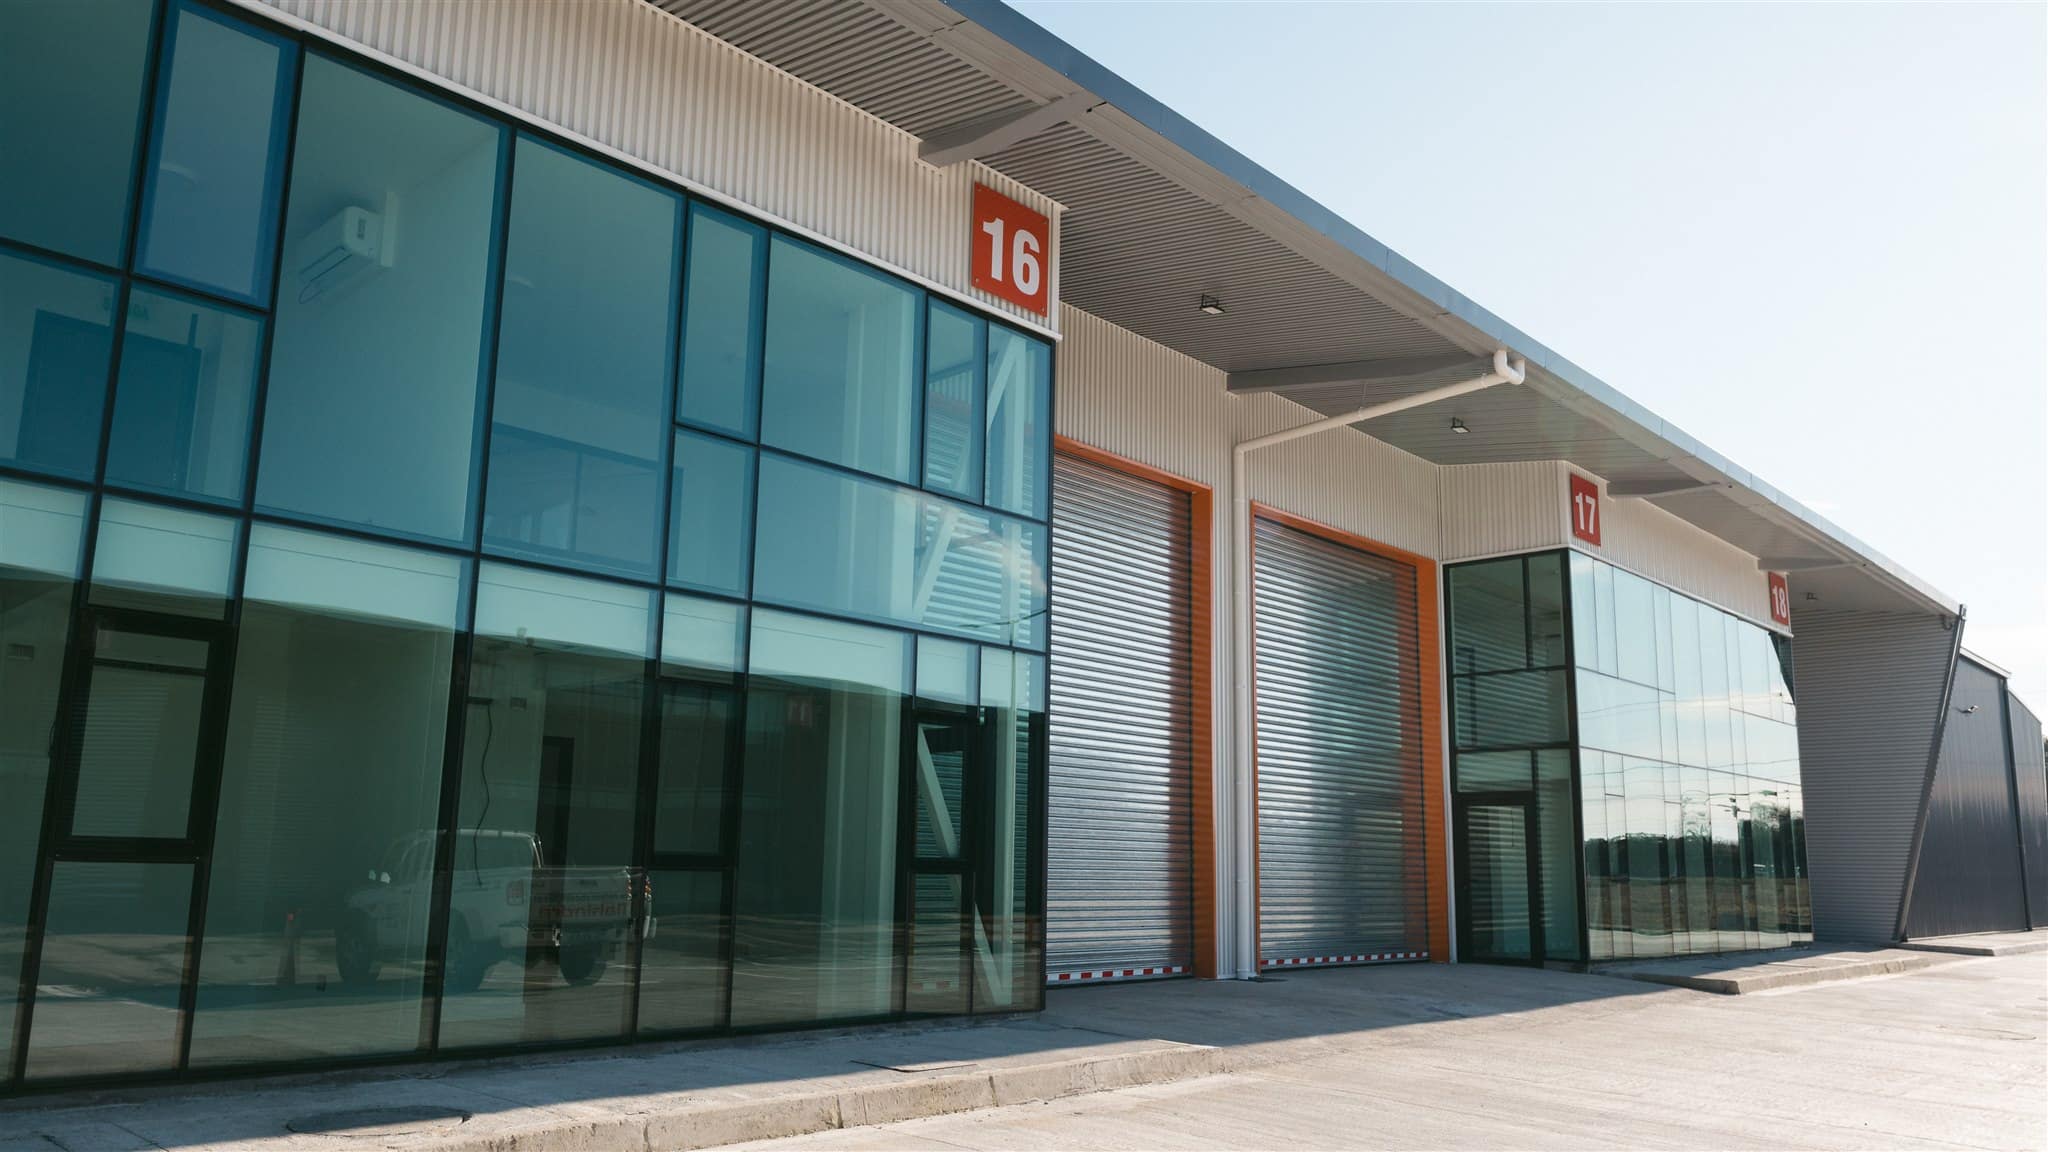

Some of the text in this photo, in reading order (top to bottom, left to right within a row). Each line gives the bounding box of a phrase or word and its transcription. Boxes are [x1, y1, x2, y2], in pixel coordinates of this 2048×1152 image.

[982, 217, 1041, 296] 16
[1575, 491, 1596, 535] 17
[1772, 584, 1787, 619] 18
